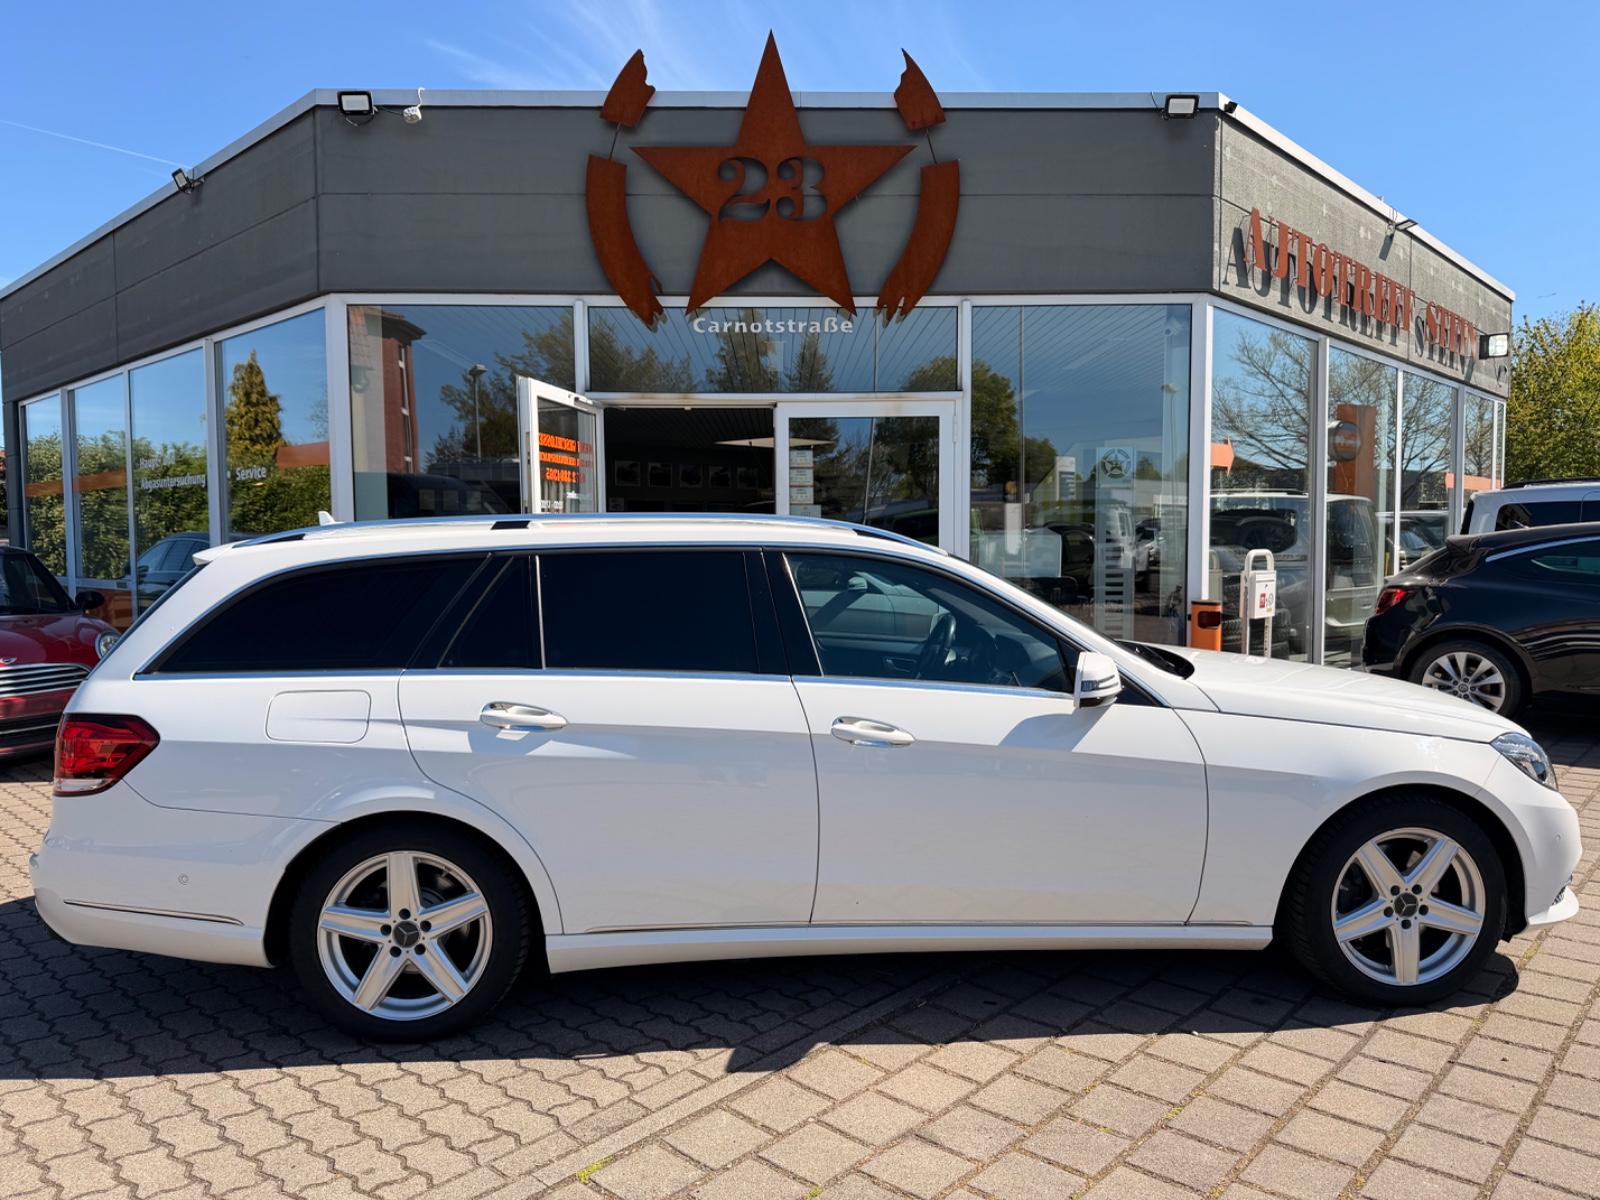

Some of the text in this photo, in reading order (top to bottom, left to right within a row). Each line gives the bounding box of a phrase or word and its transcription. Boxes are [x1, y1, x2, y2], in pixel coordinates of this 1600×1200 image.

[717, 156, 828, 222] 23
[1243, 206, 1416, 332] AUTOTREFF
[692, 316, 854, 334] Carnotstraße
[235, 465, 268, 481] Service
